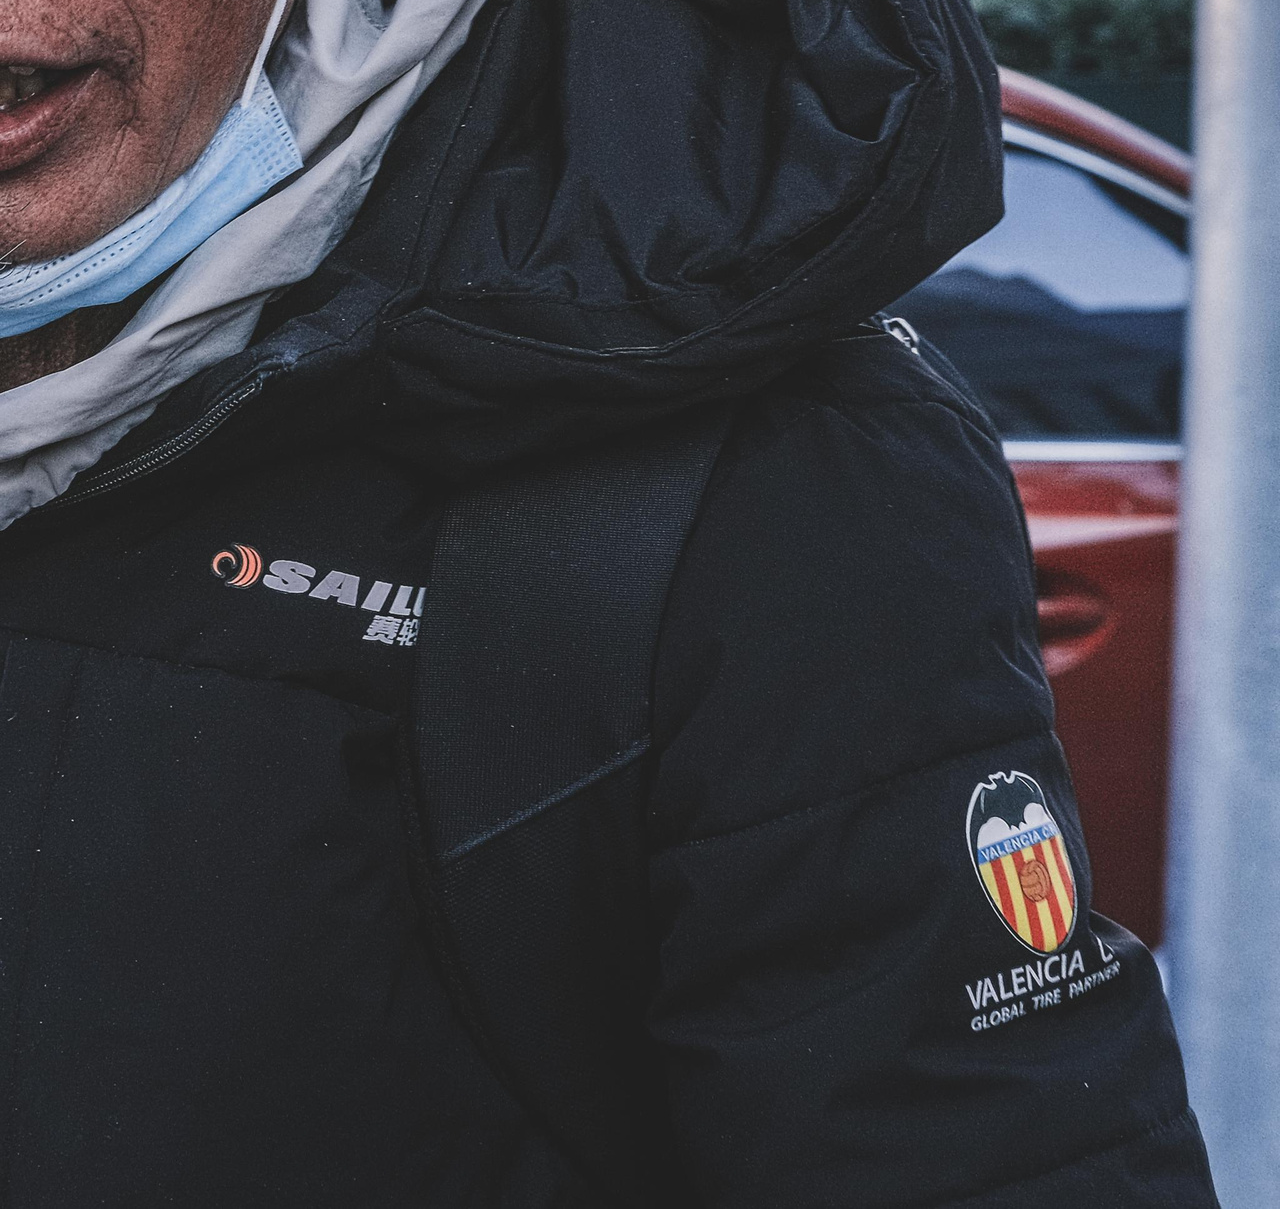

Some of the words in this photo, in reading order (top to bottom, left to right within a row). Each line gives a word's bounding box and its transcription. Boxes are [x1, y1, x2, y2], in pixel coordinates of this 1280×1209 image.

[981, 829, 1041, 862] VALENCIA
[965, 949, 1085, 1010] VALENCIA
[970, 1000, 1026, 1031] GLOBAL
[1031, 988, 1061, 1010] TIRE
